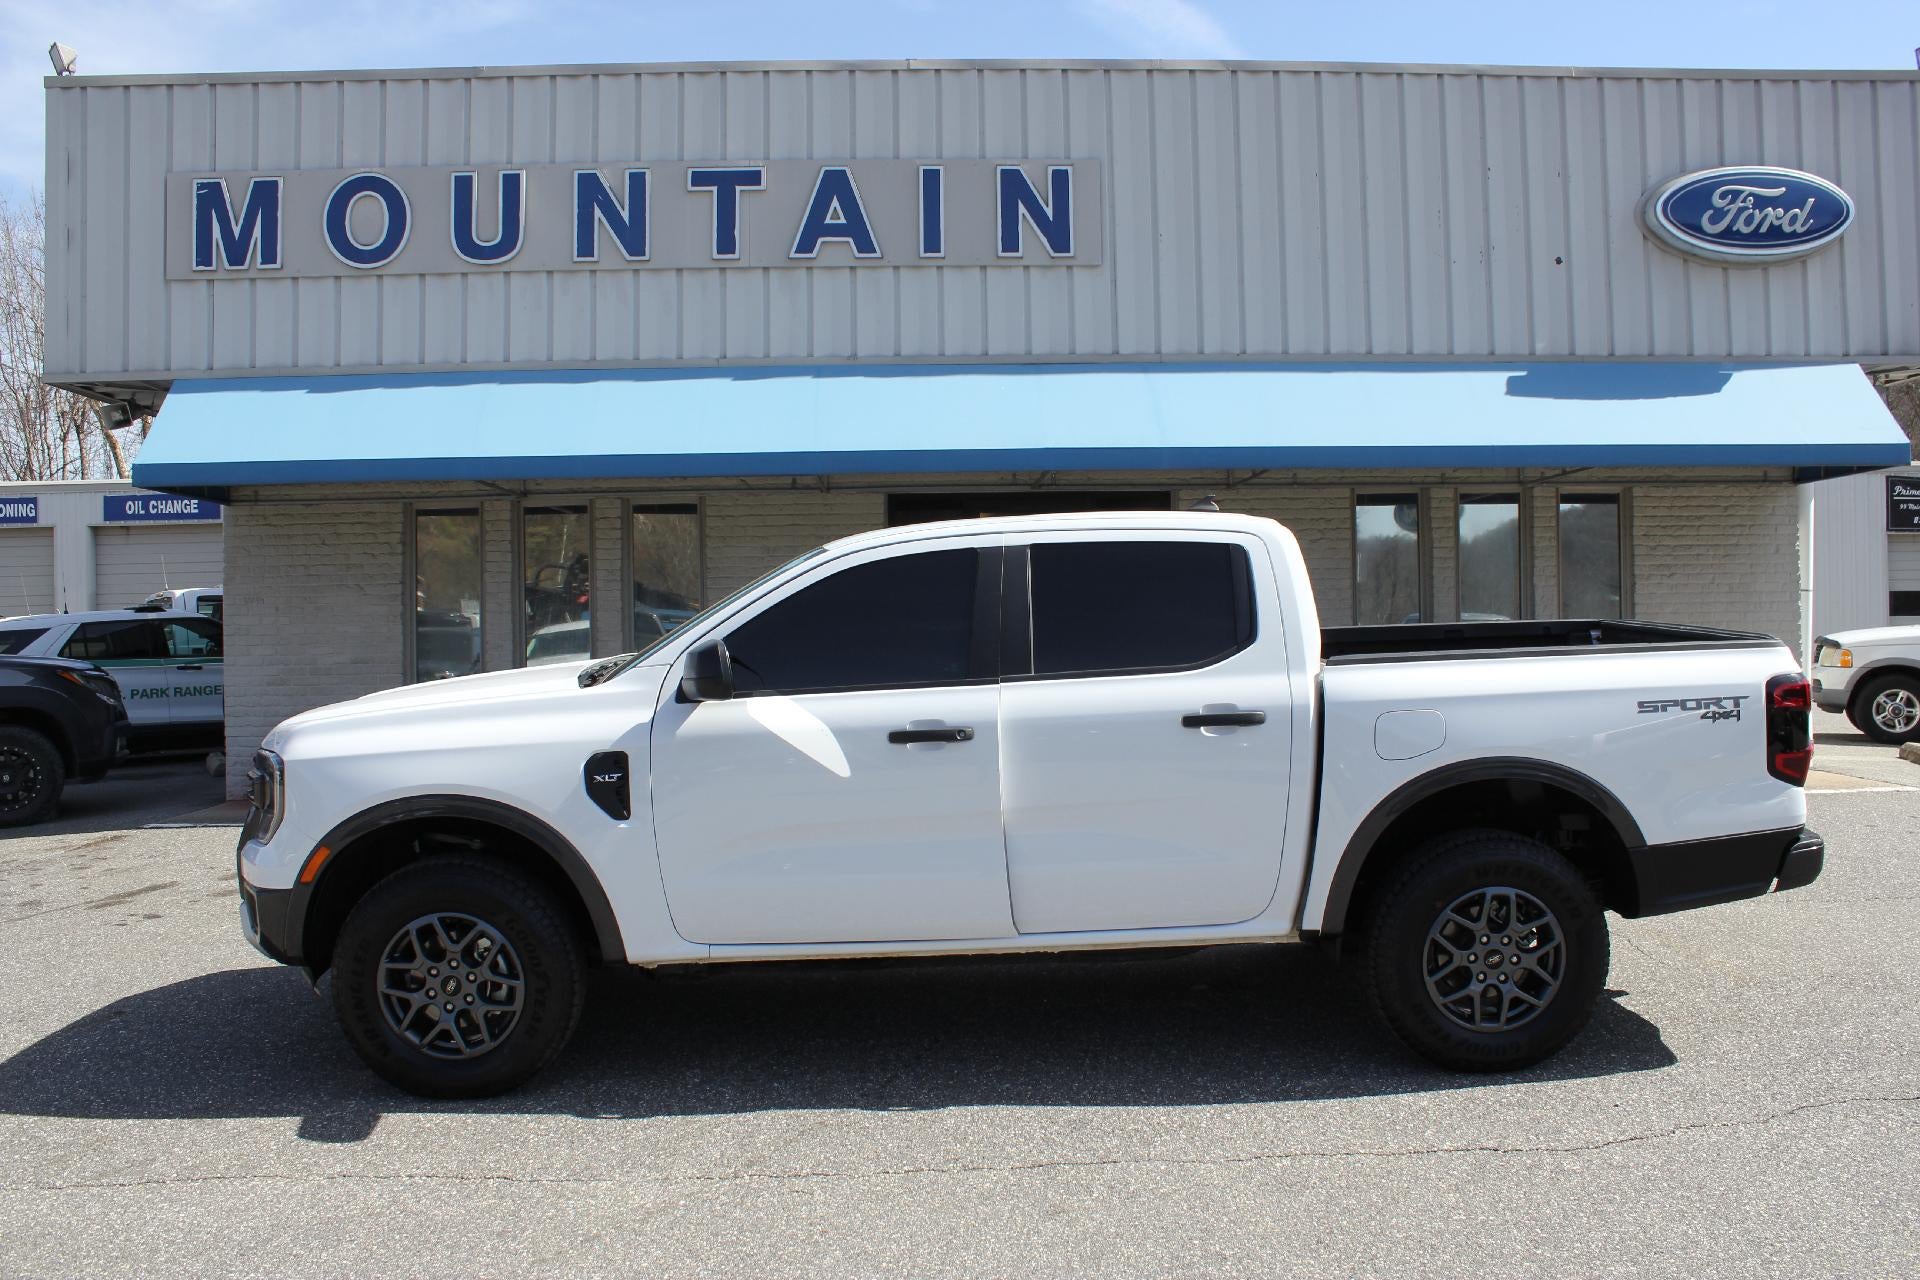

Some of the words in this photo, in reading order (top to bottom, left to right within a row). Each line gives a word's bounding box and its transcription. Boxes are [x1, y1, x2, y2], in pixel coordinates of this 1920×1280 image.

[191, 164, 1075, 271] MOUNTAIN
[1701, 185, 1816, 235] Ford
[125, 500, 146, 515] OIL
[149, 499, 199, 514] CHANGE
[130, 687, 170, 699] PARK
[1637, 695, 1750, 714] SPORT
[592, 773, 624, 783] XLT
